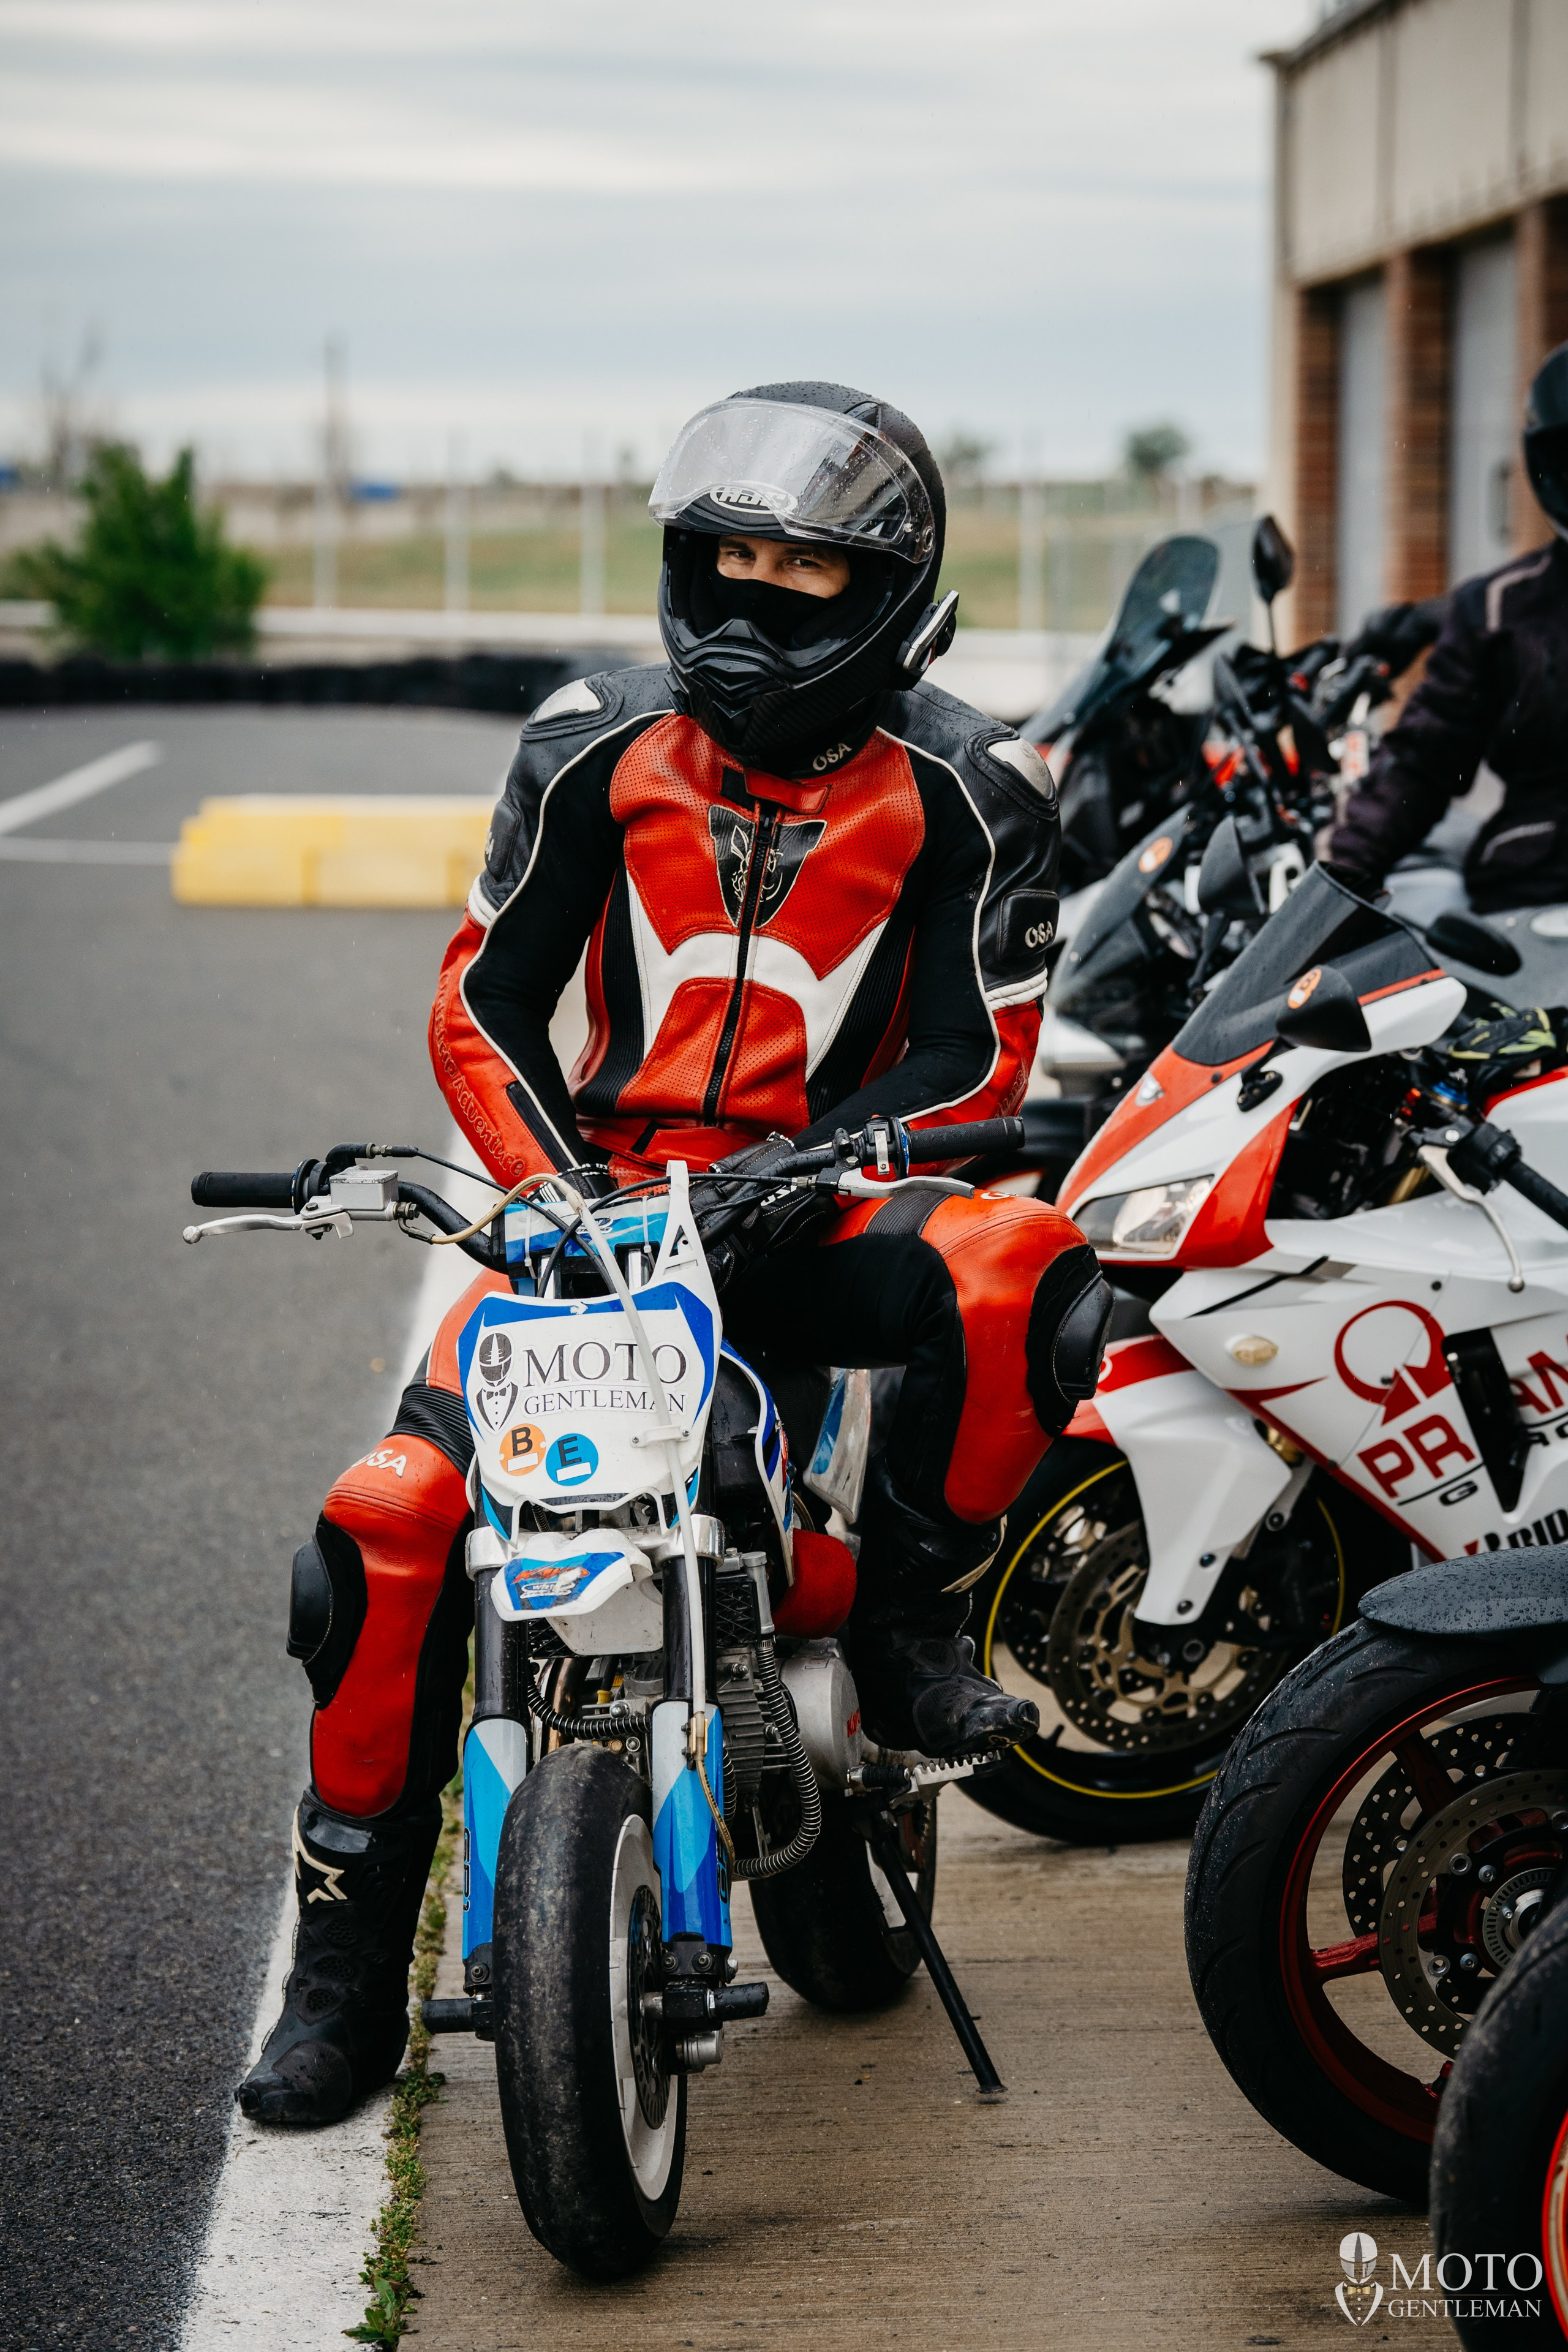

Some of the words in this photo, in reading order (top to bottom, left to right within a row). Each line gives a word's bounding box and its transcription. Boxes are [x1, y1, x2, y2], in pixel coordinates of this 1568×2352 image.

[813, 743, 852, 771] OSA
[1025, 921, 1054, 948] OSA
[452, 1074, 528, 1177] Adventure
[522, 1341, 687, 1388] MOTO
[524, 1389, 686, 1415] GENTLEMN
[511, 1427, 533, 1457] B
[557, 1436, 582, 1467] E
